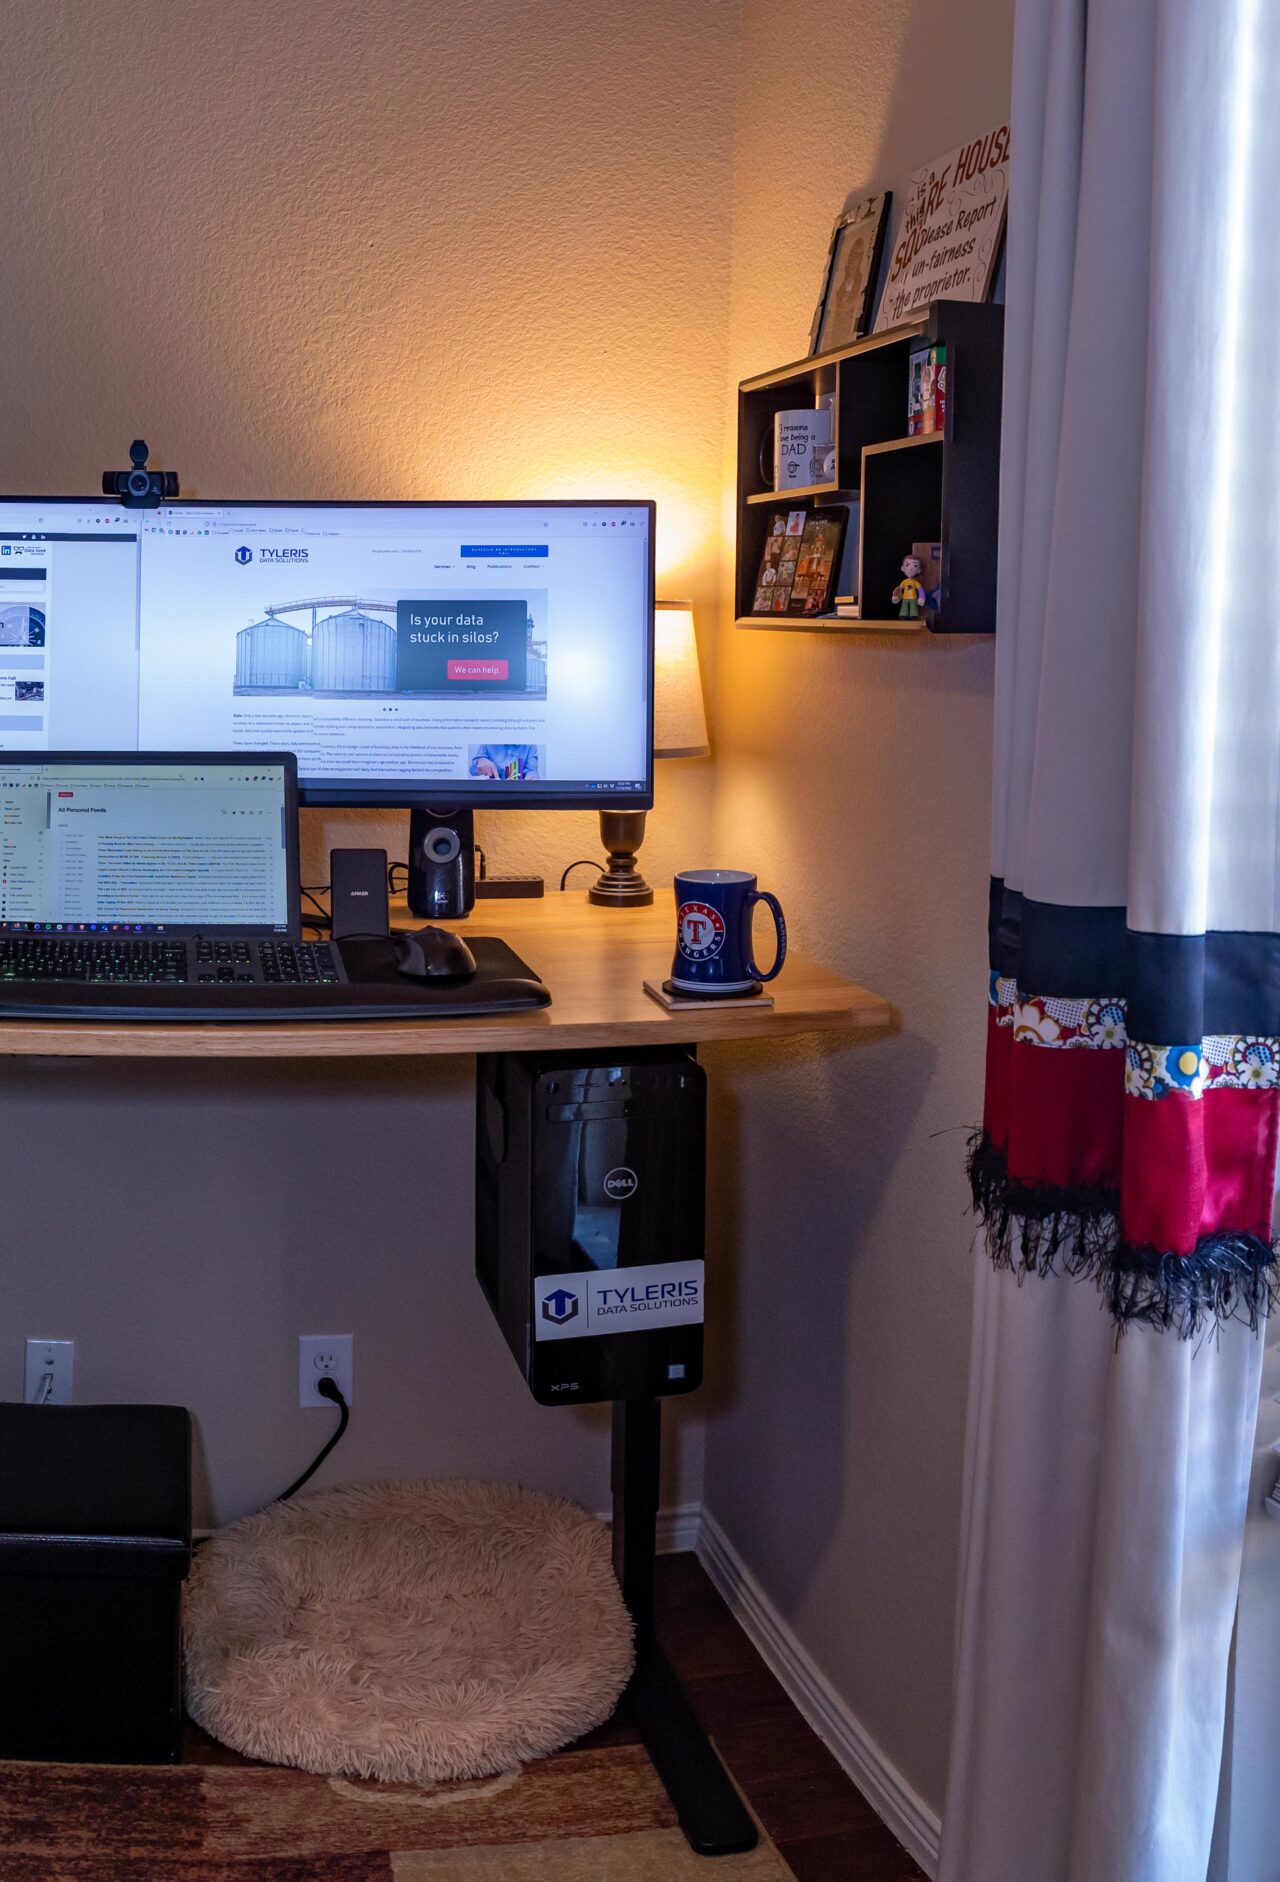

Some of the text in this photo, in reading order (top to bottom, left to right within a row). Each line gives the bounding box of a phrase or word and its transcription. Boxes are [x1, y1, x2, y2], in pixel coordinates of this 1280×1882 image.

[956, 195, 998, 231] Report
[912, 237, 976, 278] un-fairness
[912, 267, 971, 309] proprietor.
[791, 434, 808, 442] being
[782, 444, 806, 456] DAD
[260, 549, 308, 557] TYLERIS
[410, 614, 484, 628] Is your data
[410, 632, 499, 643] stuck in silos?
[679, 904, 718, 922] TEXAS
[687, 919, 707, 945] T
[678, 931, 722, 959] RANGERS
[607, 1178, 634, 1188] DELL
[597, 1279, 699, 1306] TYLERIS
[597, 1297, 699, 1317] DATA SOLUTIONS
[550, 1382, 579, 1392] XPS
